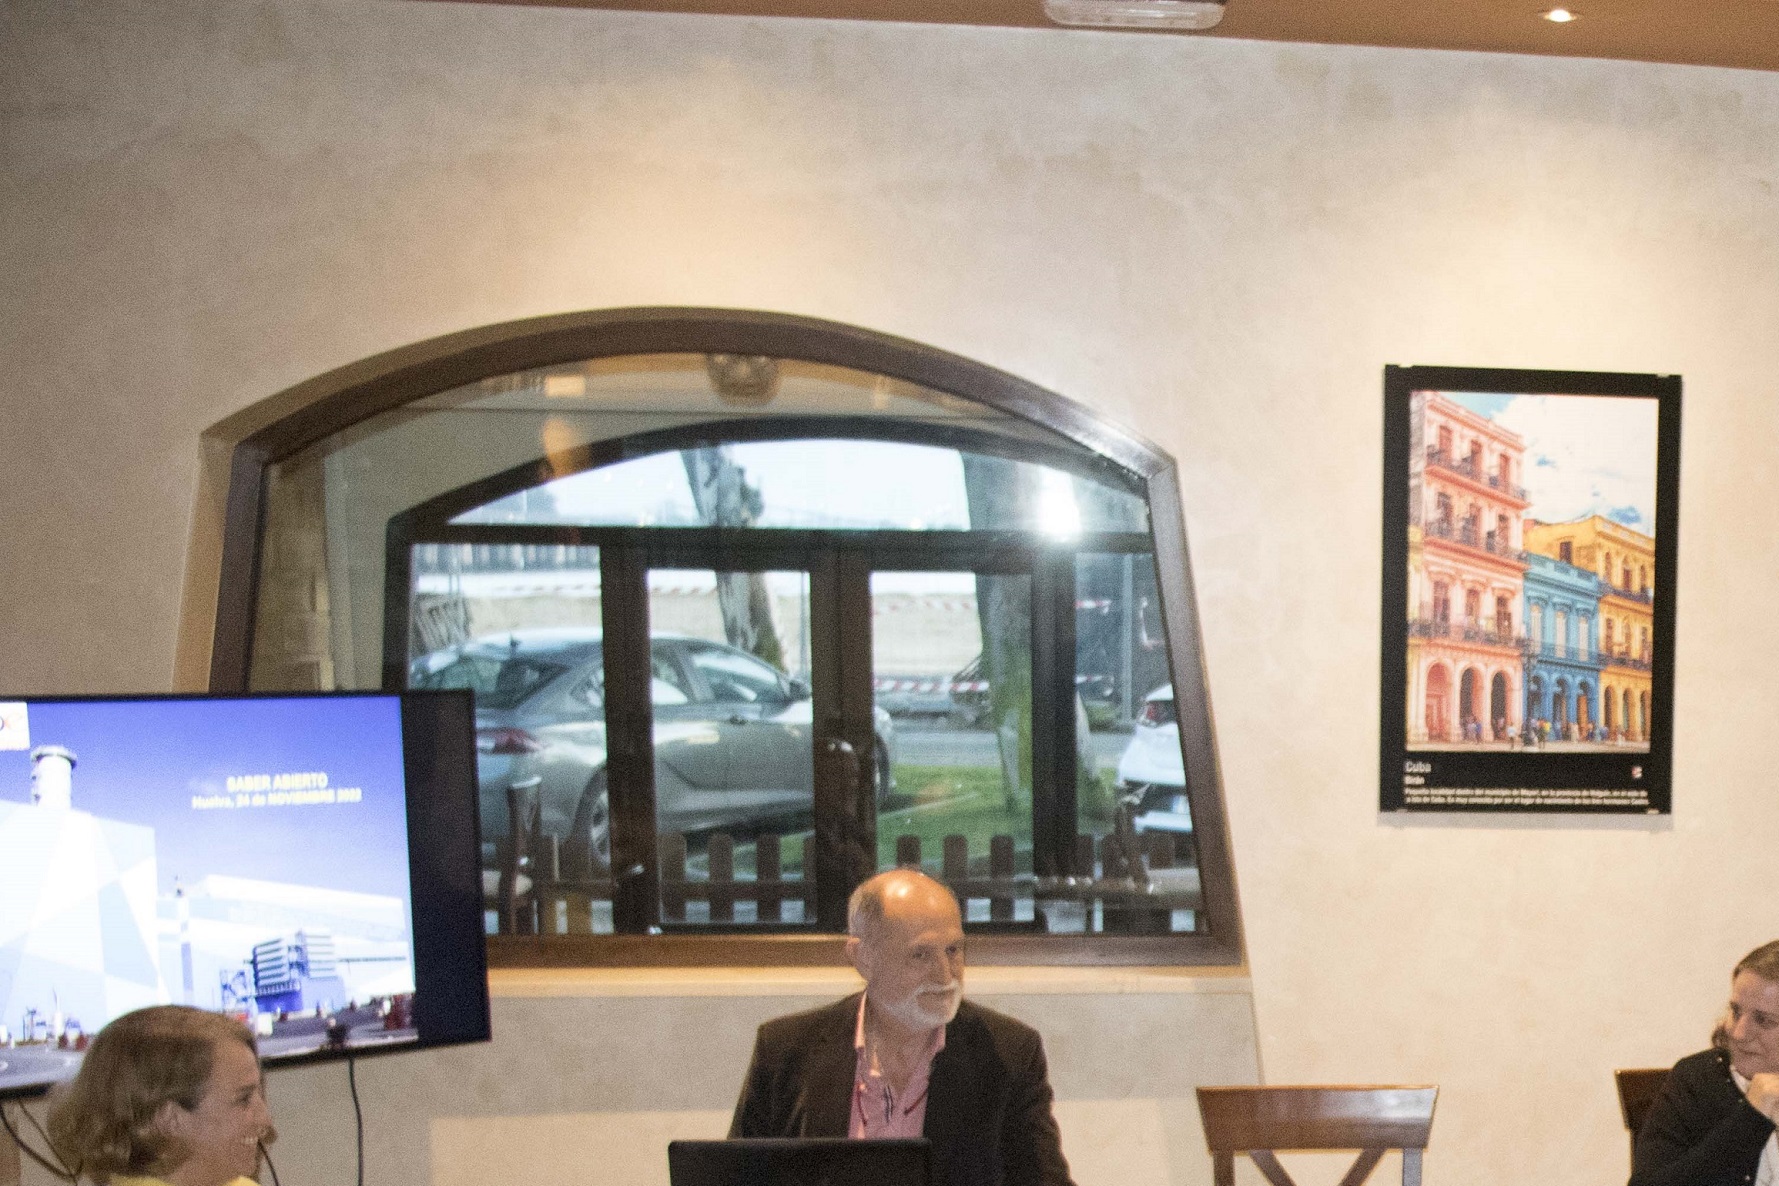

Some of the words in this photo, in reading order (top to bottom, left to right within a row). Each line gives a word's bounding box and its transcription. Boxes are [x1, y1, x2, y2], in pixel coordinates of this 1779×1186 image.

[1404, 760, 1432, 773] Cuba
[227, 774, 271, 792] SABER
[273, 772, 328, 790] ABIERTO
